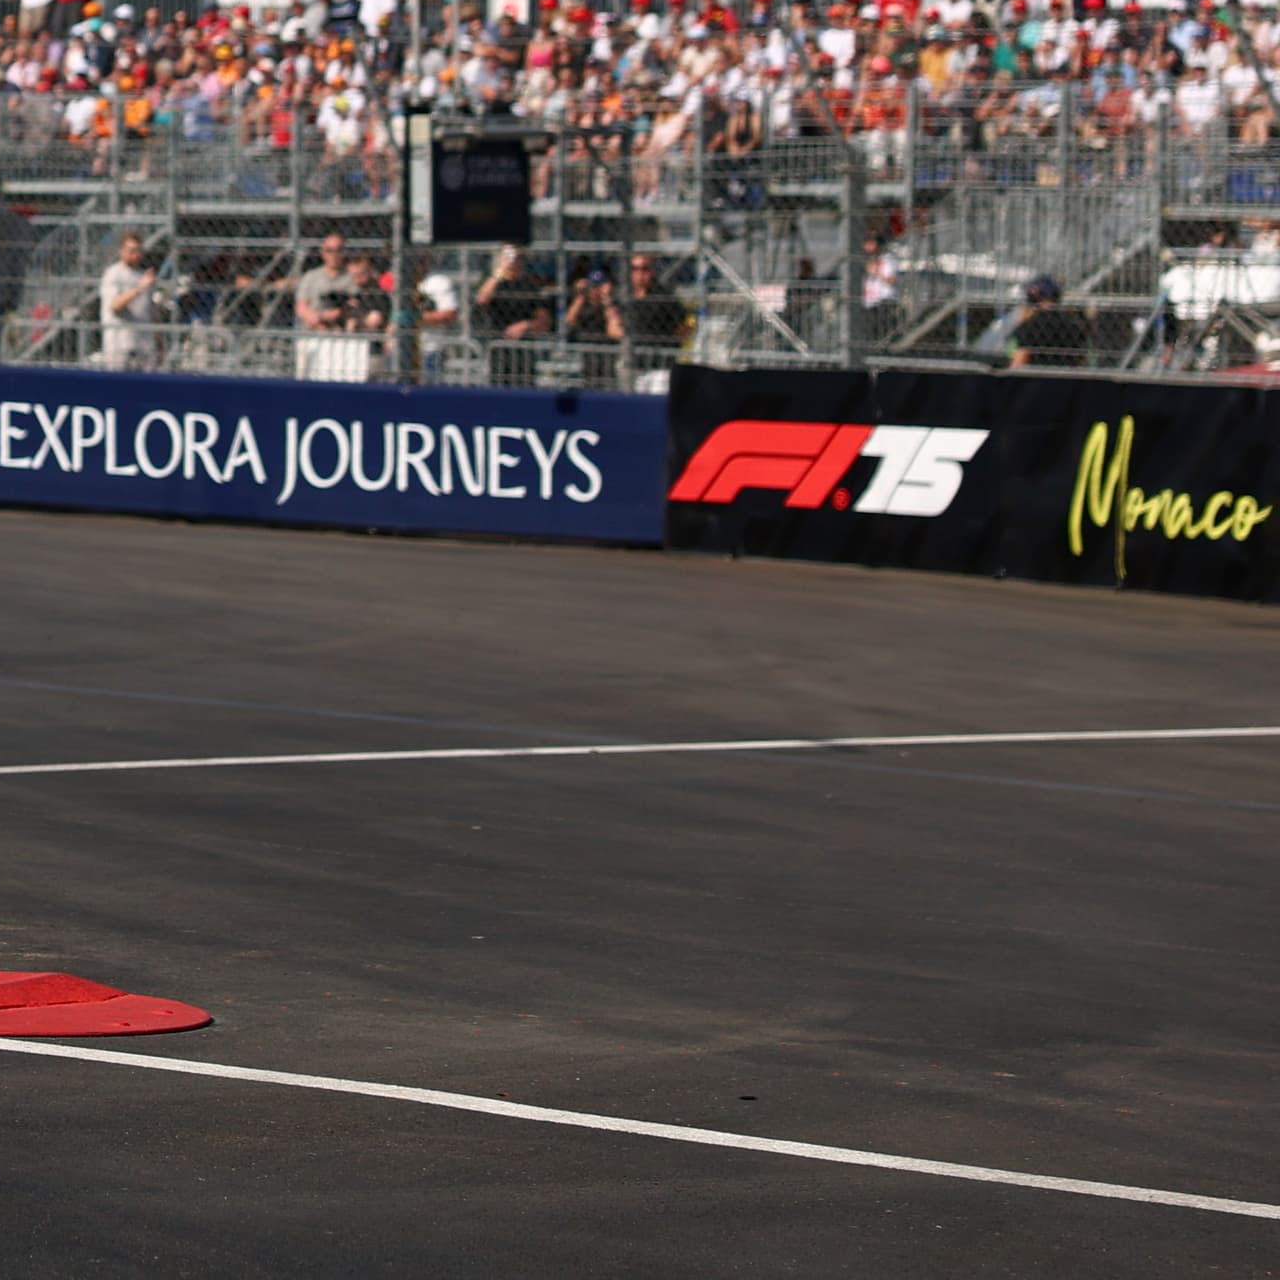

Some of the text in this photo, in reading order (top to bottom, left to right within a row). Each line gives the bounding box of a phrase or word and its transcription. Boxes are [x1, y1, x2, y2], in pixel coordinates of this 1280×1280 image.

[0, 401, 603, 505] EXPLORA JOURNEYS
[1068, 415, 1272, 578] Monaco
